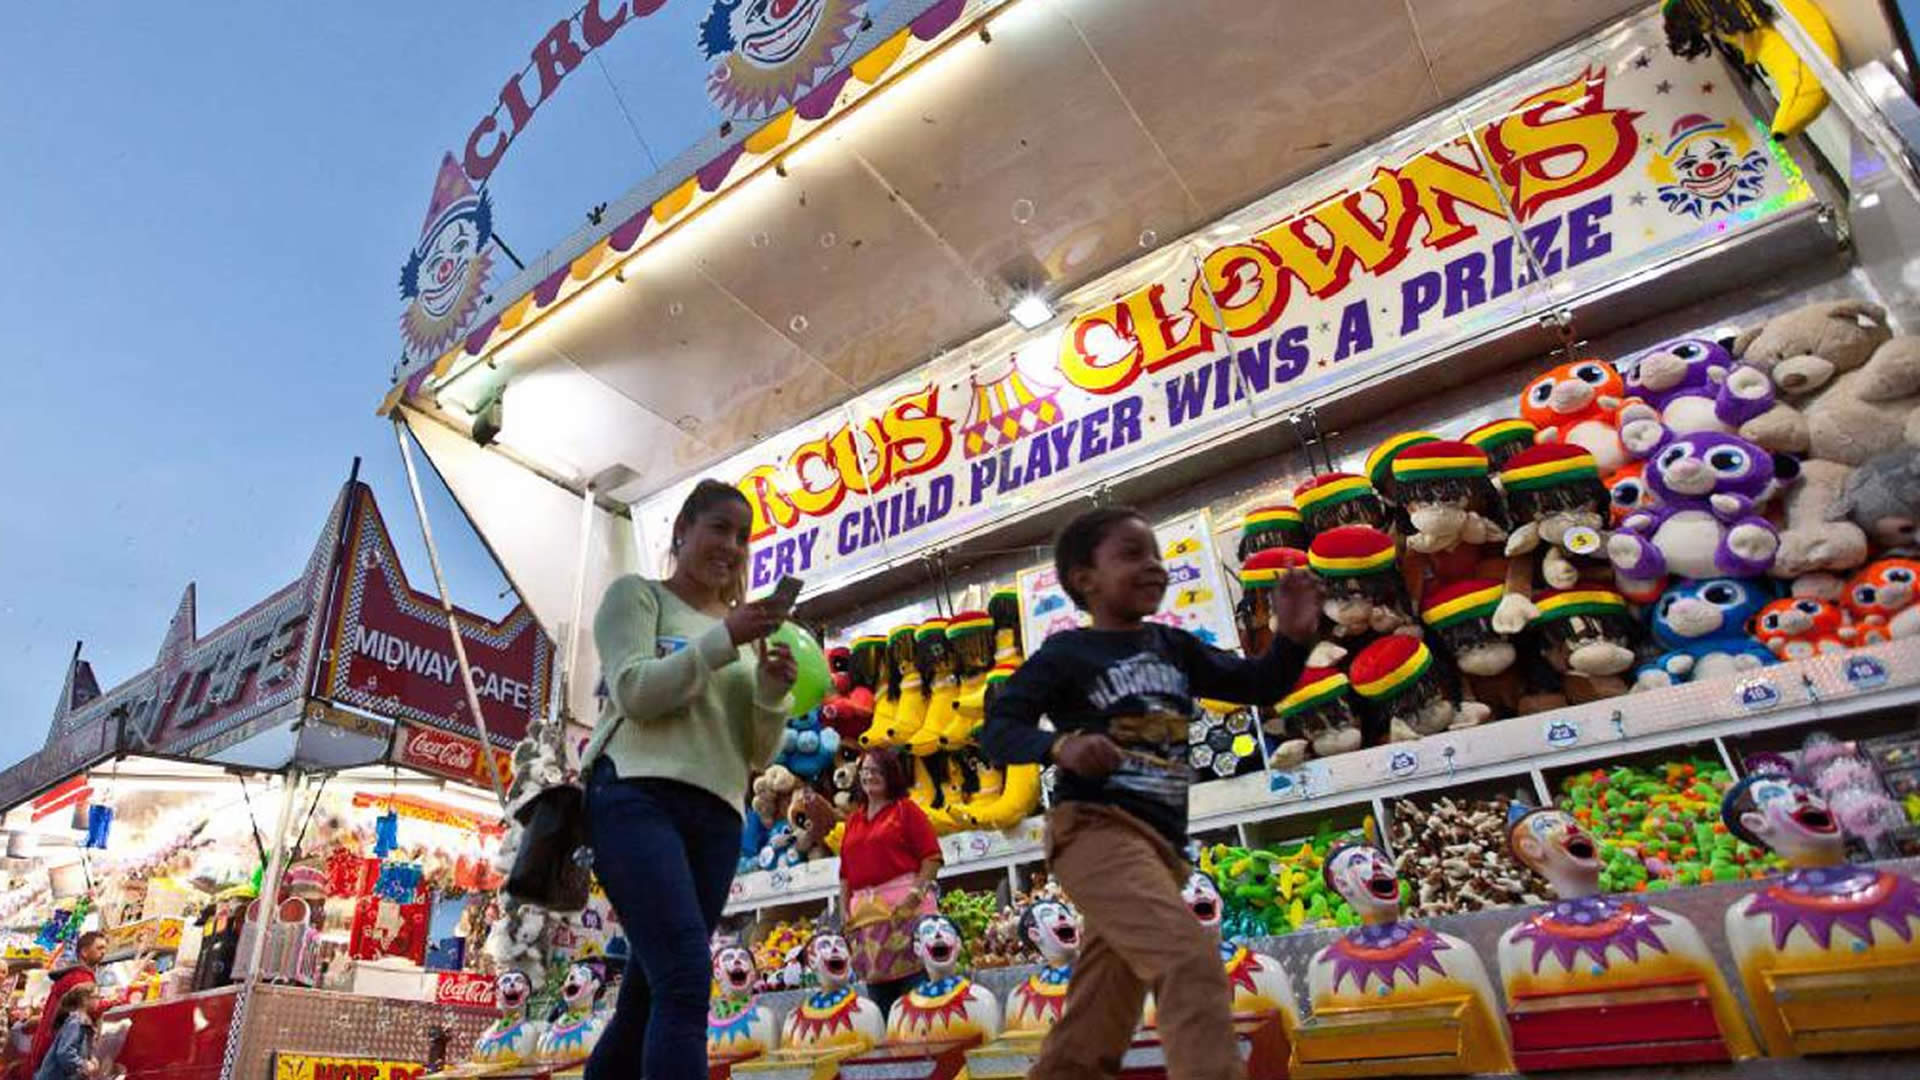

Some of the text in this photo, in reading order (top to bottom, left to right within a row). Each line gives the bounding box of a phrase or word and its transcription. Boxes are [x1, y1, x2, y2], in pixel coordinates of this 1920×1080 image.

[464, 0, 667, 181] CIRC
[739, 64, 1646, 543] RCUS CLOWNS
[752, 194, 1612, 590] ERY CHILD PLAYER WINS A PRIZE
[354, 625, 529, 710] MIDWAY CAFE
[409, 728, 473, 769] Coca-Cola
[439, 977, 493, 1003] Coca-Cola
